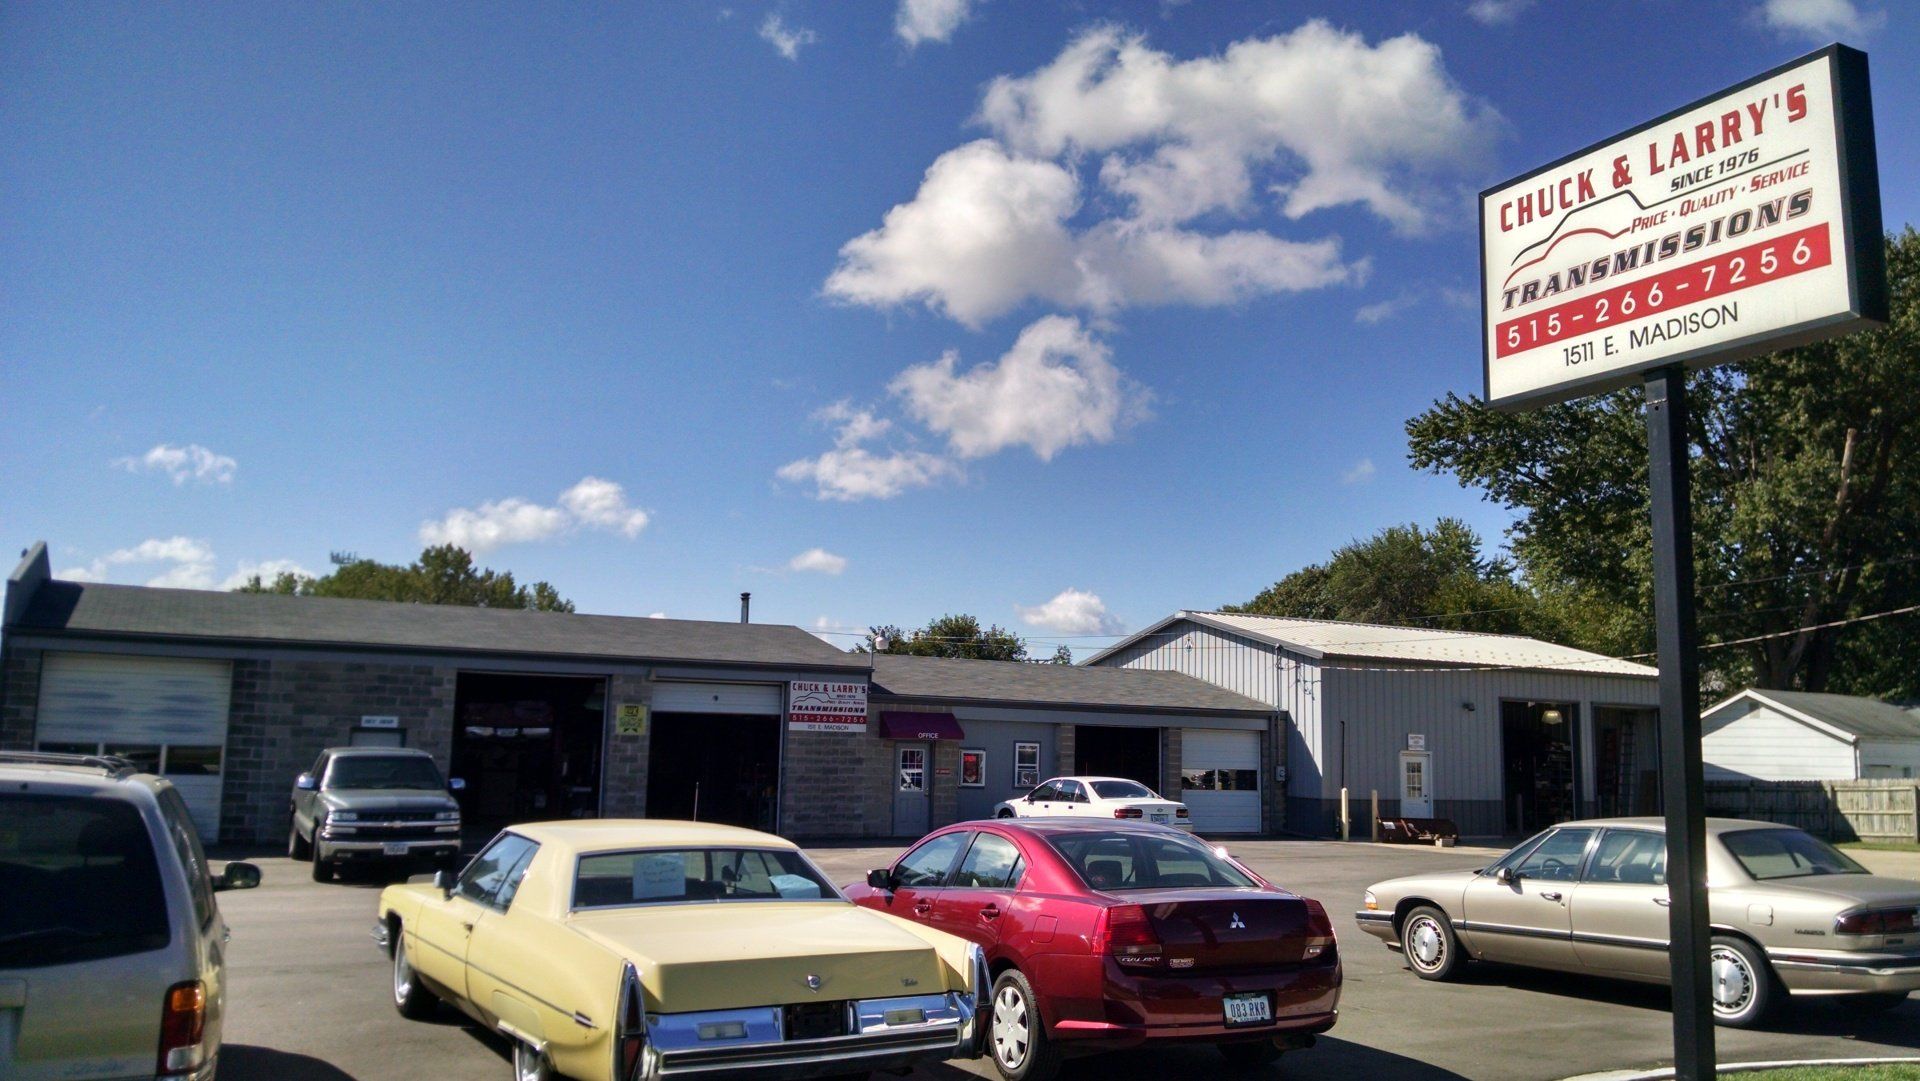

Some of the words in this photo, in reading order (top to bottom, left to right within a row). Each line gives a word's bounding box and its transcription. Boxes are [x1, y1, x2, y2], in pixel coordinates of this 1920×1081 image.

[1500, 168, 1596, 233] CHUCK
[1612, 154, 1633, 190] &
[1649, 83, 1808, 176] LARRY'S
[1670, 163, 1714, 193] SINCE
[1718, 147, 1760, 175] 1976
[1631, 209, 1668, 234] PRICE
[1679, 185, 1738, 218] QUALITY
[1750, 160, 1811, 193] SERVICE
[1502, 187, 1813, 312] TRANSMISSIONS
[1507, 237, 1811, 349] 515-266-7256
[1562, 340, 1595, 367] 1511
[1604, 336, 1619, 357] E.
[1630, 301, 1739, 350] MADISON
[792, 682, 820, 692] CHUCK
[823, 683, 829, 693] &
[832, 684, 866, 694] LARRY'S
[792, 705, 866, 713] TRANSMISSIONS
[1230, 1002, 1248, 1018] 083
[1248, 1001, 1267, 1017] RKR
